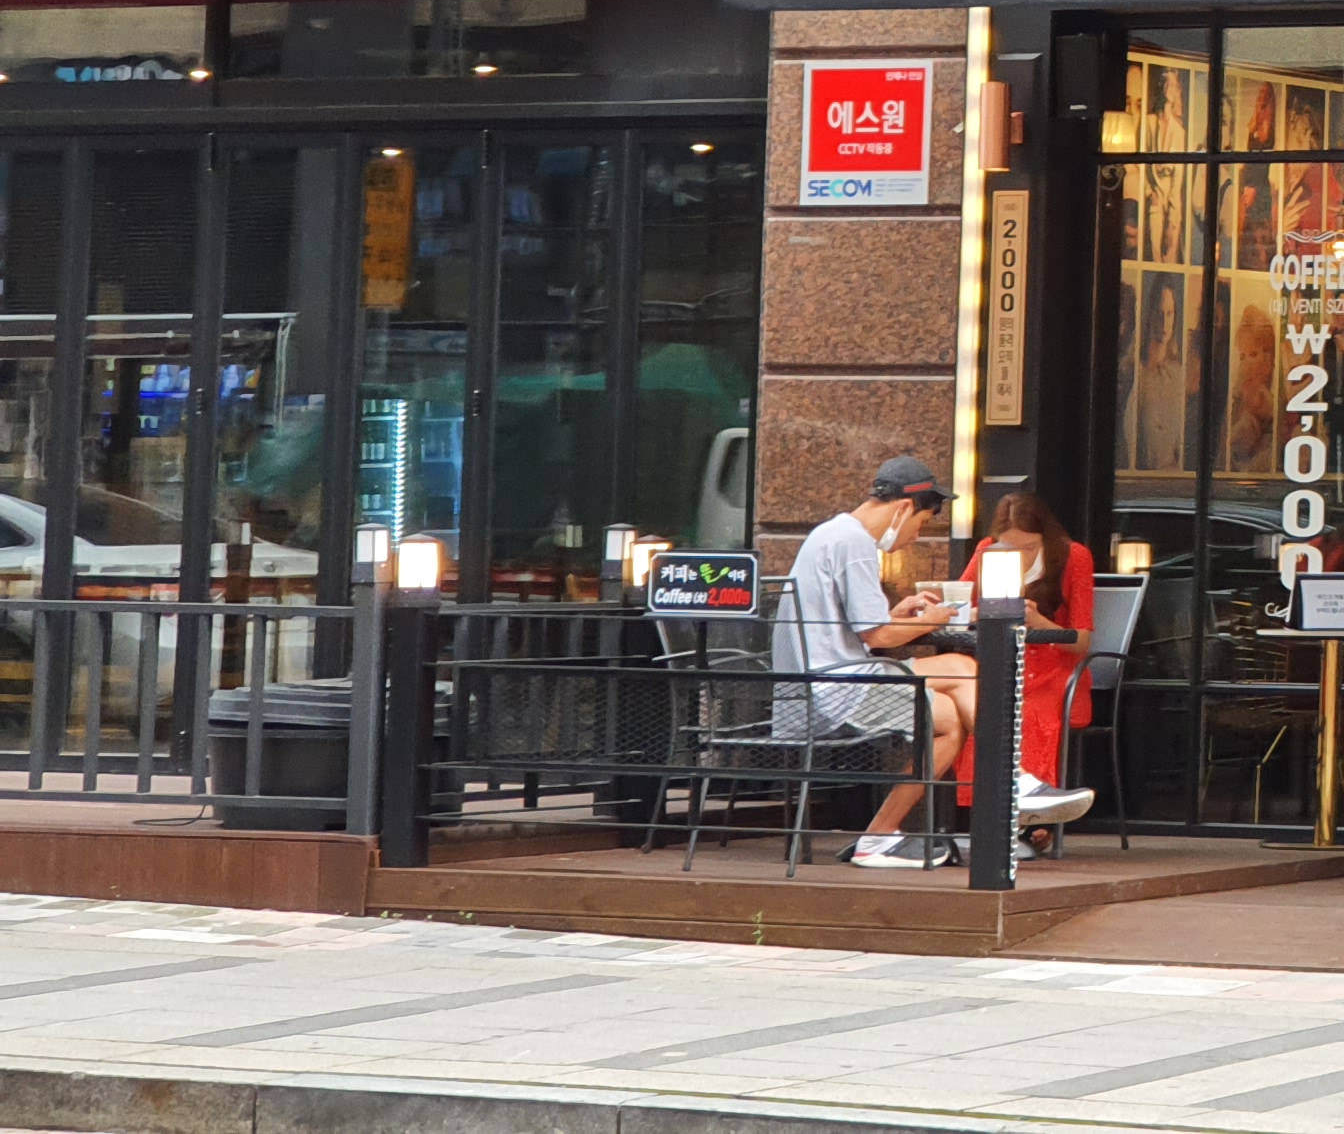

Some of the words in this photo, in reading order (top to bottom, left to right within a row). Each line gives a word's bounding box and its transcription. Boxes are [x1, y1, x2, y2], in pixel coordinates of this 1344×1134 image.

[826, 99, 906, 135] 에스원
[837, 142, 866, 155] CCTV
[807, 178, 873, 199] SECOM
[1291, 298, 1322, 315] VENTI
[660, 564, 698, 583] 커피는
[654, 587, 693, 605] Coffee
